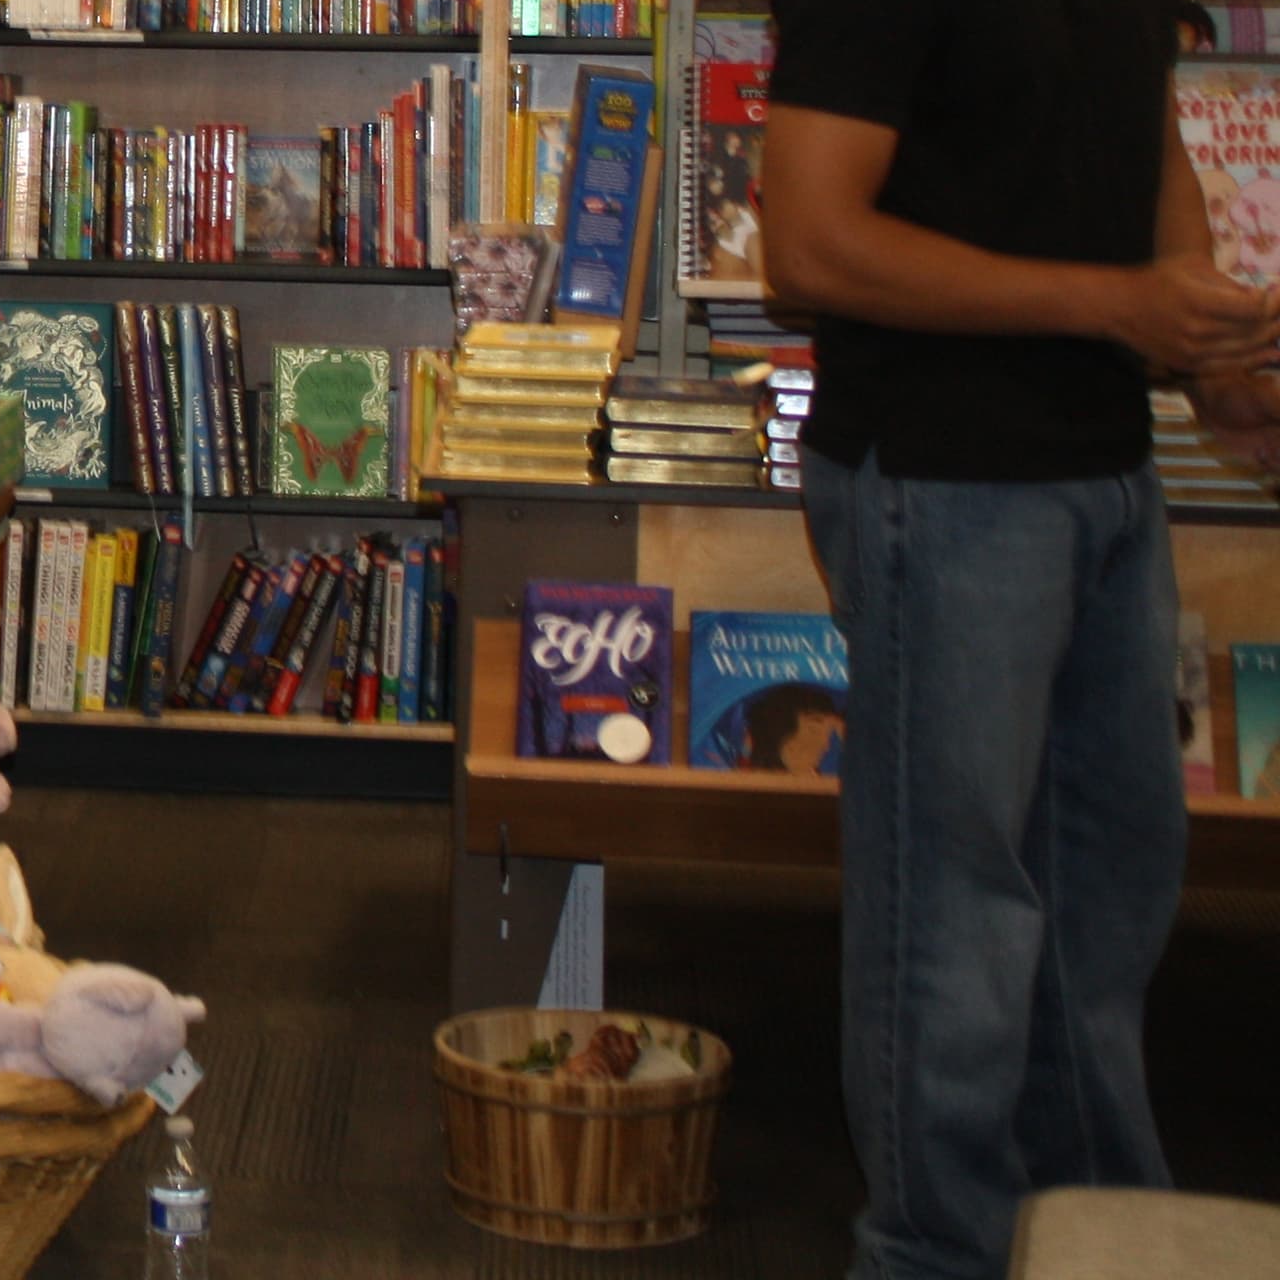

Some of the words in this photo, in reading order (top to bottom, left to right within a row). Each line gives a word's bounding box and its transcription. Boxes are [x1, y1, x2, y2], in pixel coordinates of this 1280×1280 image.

[1212, 123, 1269, 142] LOVE
[711, 622, 815, 655] AUTUMN
[711, 651, 801, 681] WATER
